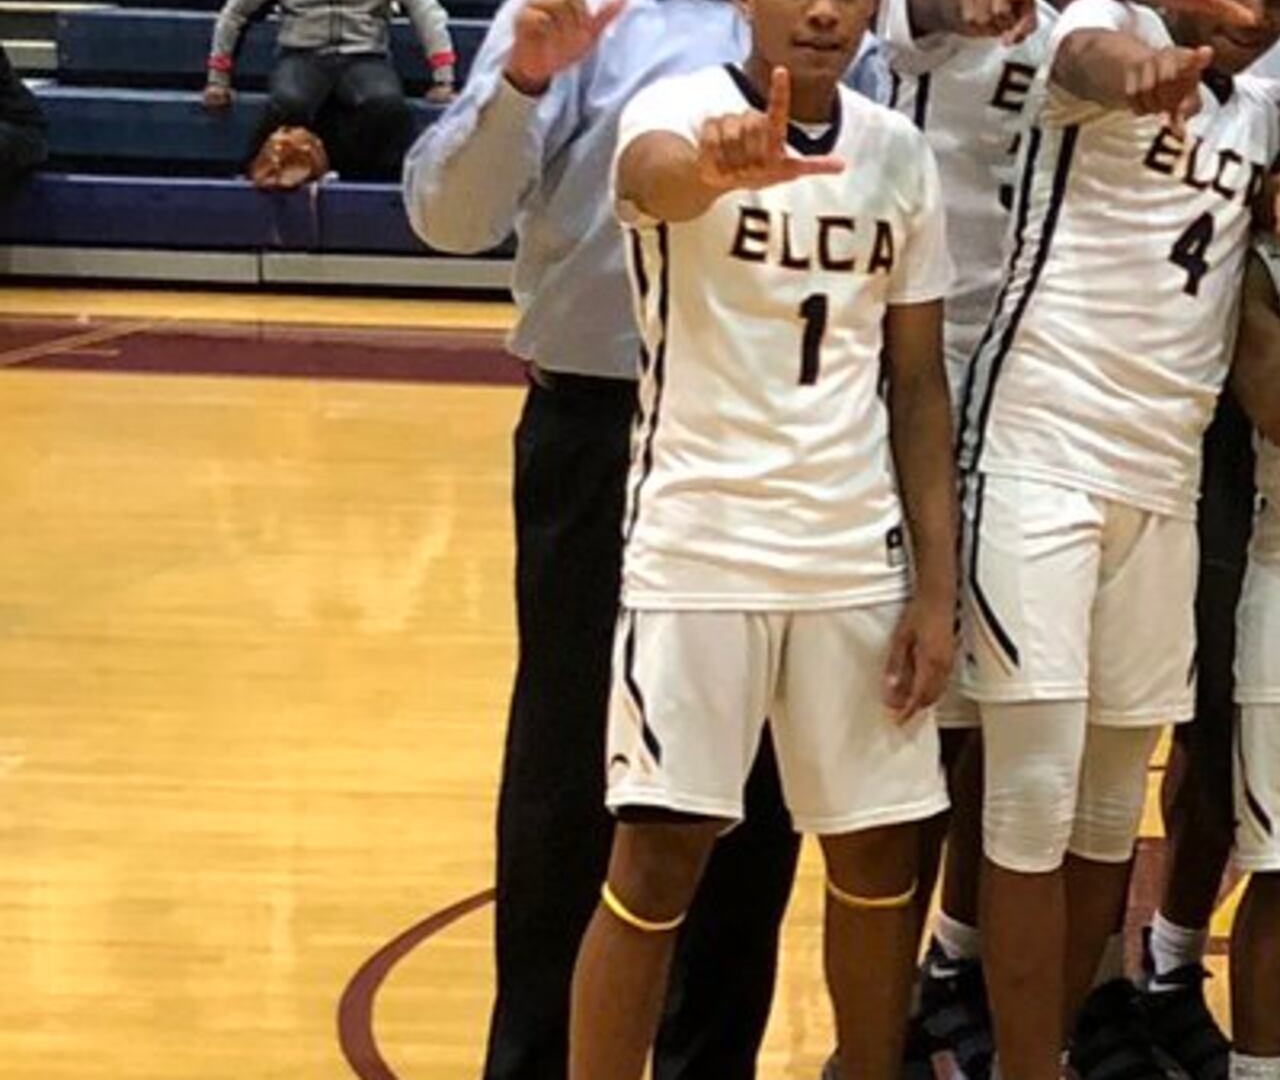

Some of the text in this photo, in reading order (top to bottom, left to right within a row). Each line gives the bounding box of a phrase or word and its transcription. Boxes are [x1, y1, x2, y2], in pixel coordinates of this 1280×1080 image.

[730, 206, 895, 275] ELCA
[1168, 210, 1215, 298] 4
[797, 292, 828, 386] 1
